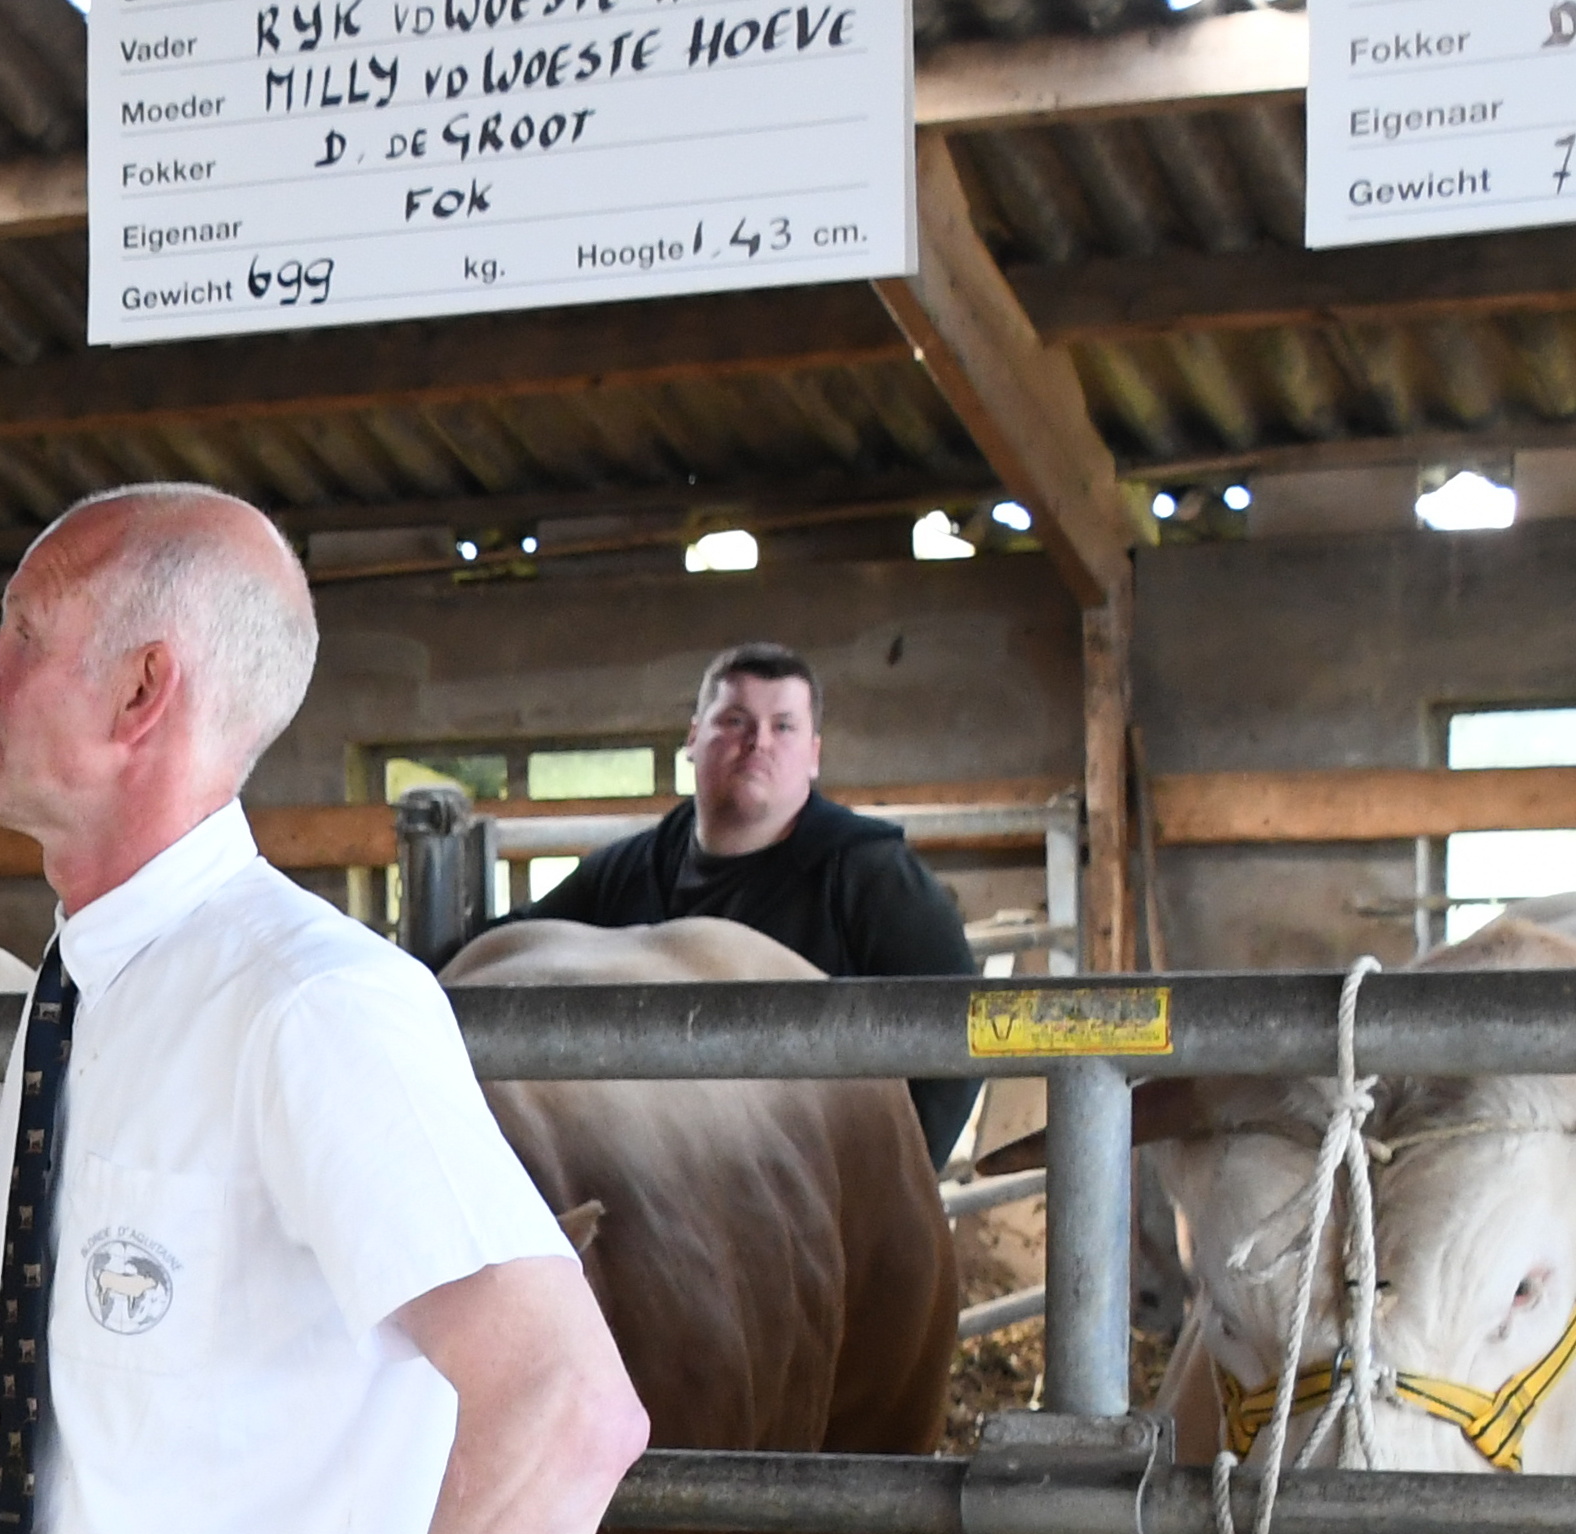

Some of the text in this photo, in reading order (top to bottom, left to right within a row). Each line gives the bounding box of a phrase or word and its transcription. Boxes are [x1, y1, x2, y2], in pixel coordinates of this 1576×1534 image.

[120, 35, 198, 64] Vader
[121, 5, 857, 126] Moeder MILLY VD WOESTE HOEVE
[1350, 30, 1471, 66] Fokker
[122, 158, 217, 188] Fokker
[384, 128, 428, 159] DE
[441, 106, 597, 162] GROOT
[1350, 99, 1504, 140] Eigenaar
[122, 177, 493, 253] Eigenaar FOK
[1349, 167, 1493, 207] Gewicht
[121, 280, 234, 312] Gewicht
[248, 253, 335, 306] 699
[463, 256, 507, 284] kg.
[577, 240, 685, 271] Hoogte
[813, 221, 868, 248] cm.
